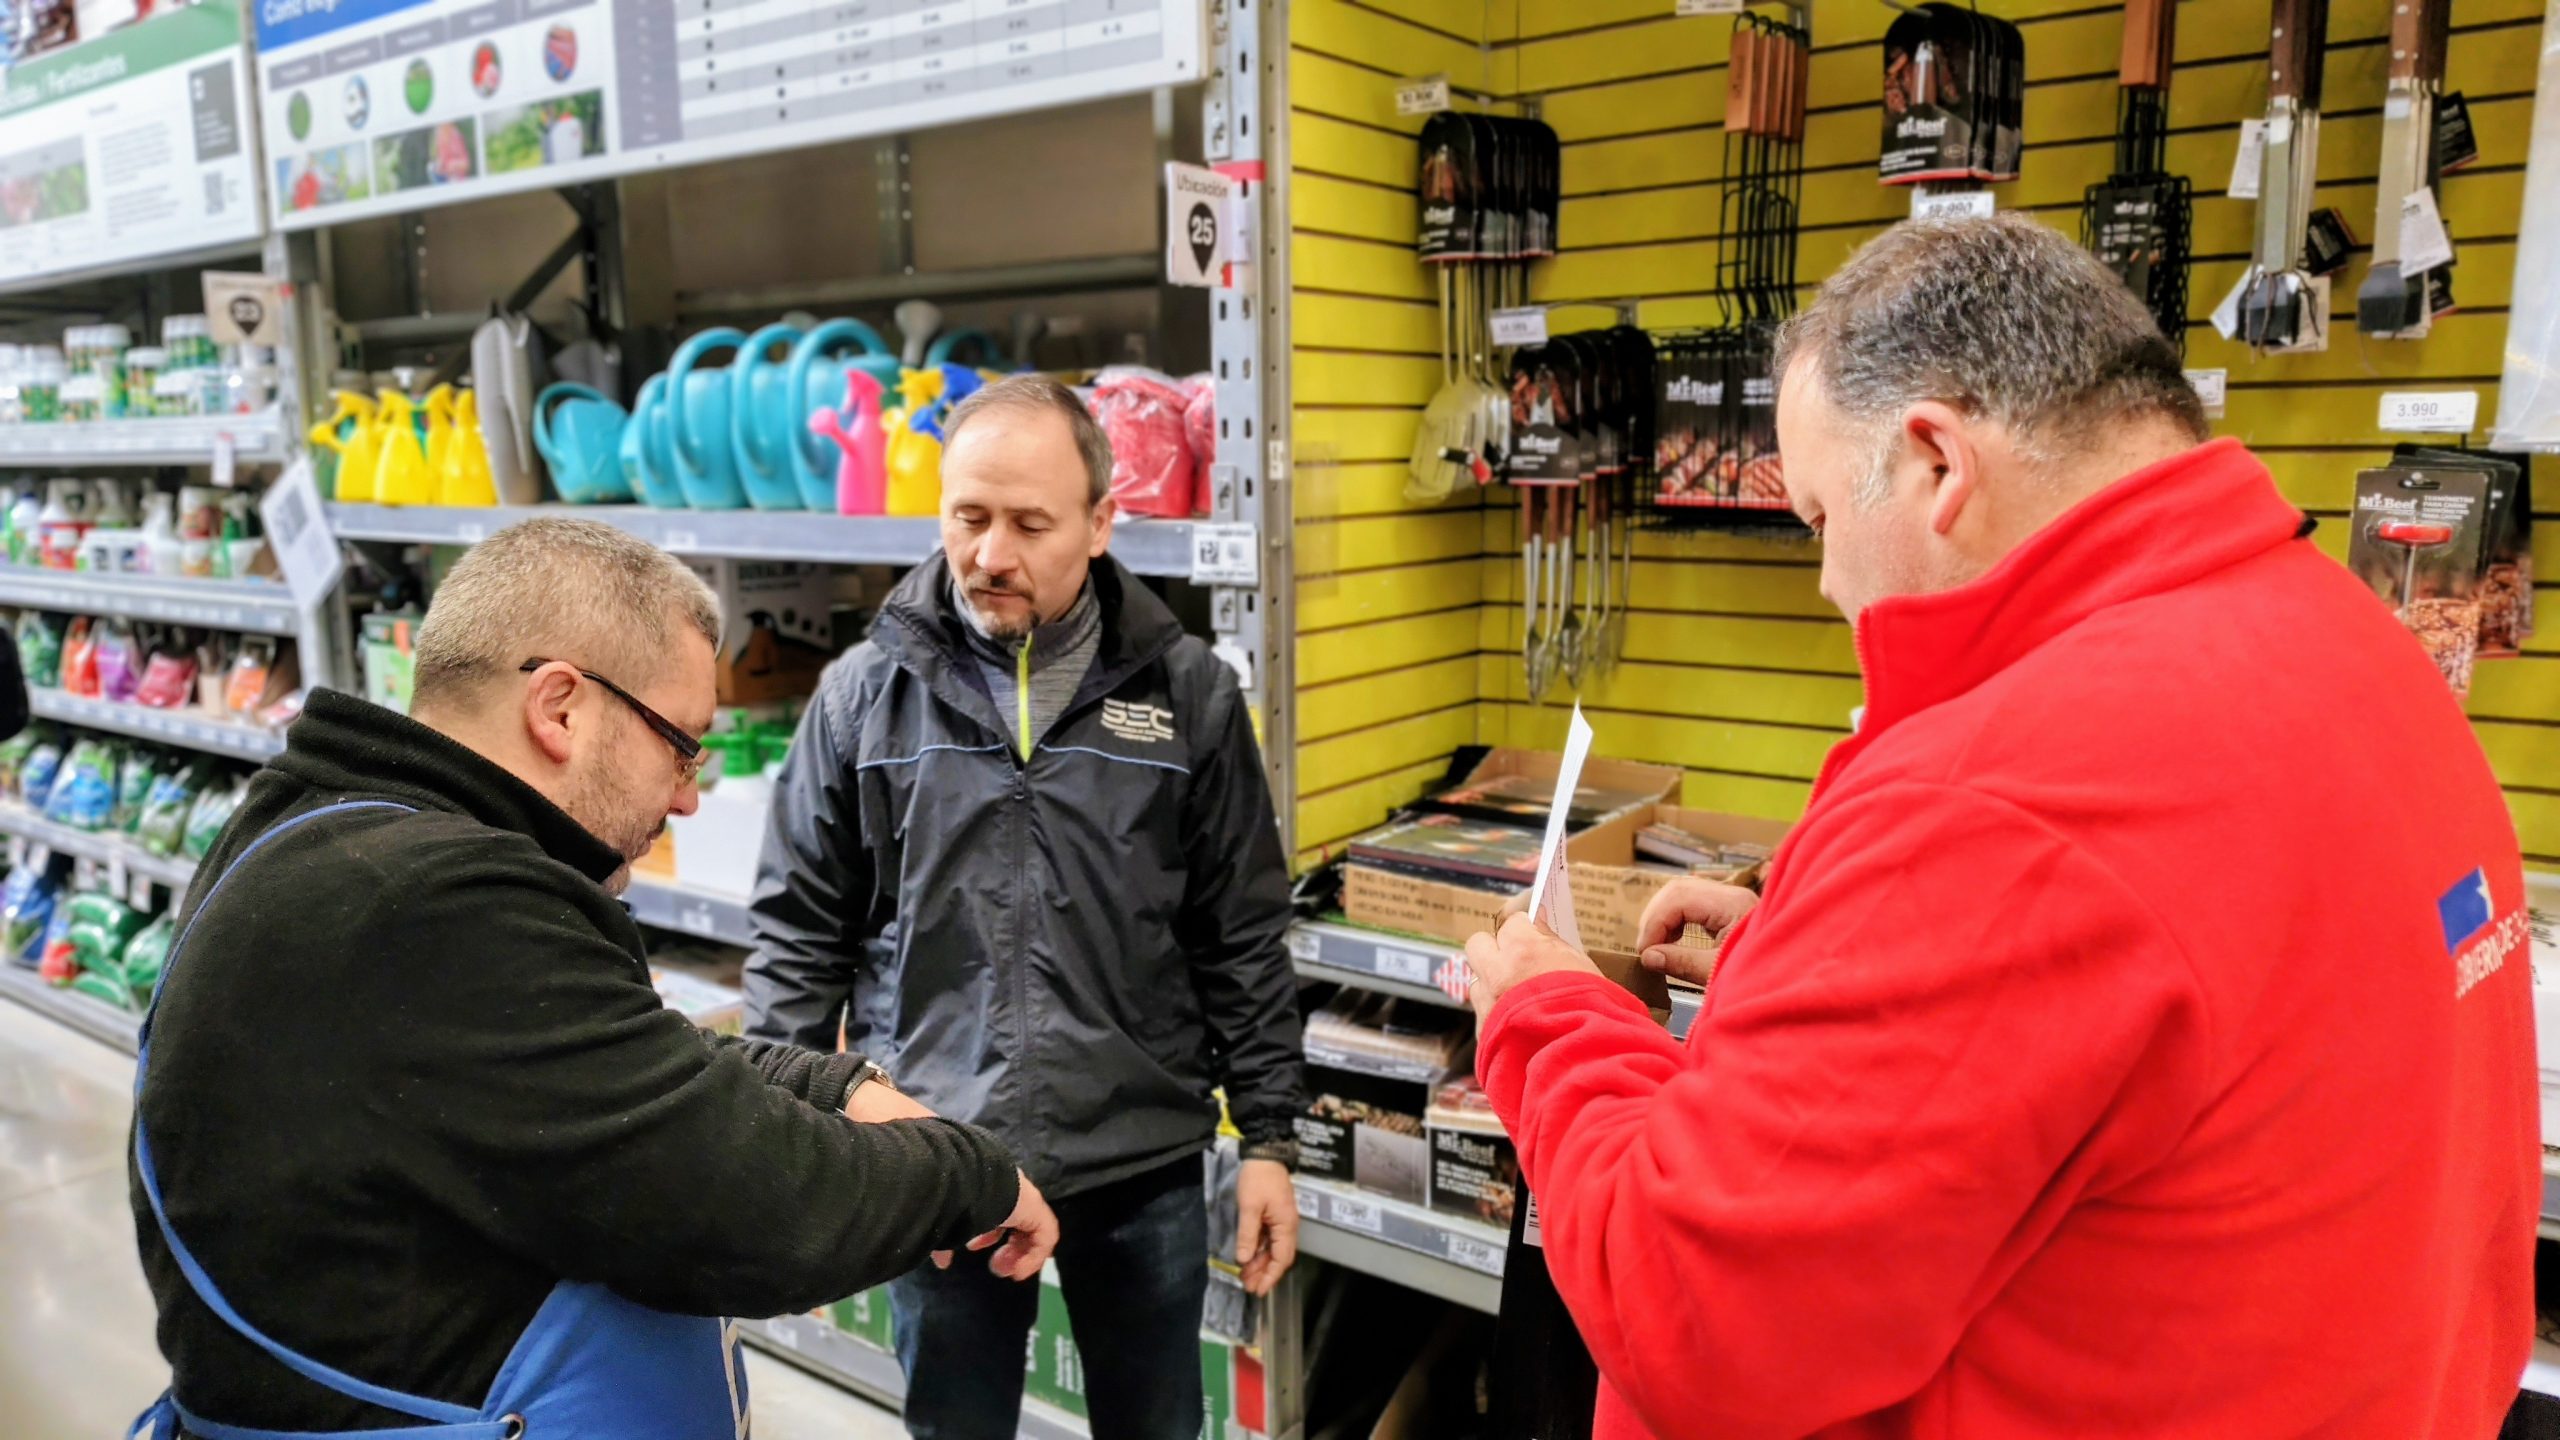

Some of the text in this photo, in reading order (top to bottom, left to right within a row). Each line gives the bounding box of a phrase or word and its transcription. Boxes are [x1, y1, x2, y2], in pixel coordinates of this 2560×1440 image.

[1177, 174, 1227, 198] Ubicación
[1191, 214, 1214, 245] 25
[2397, 402, 2438, 417] 3.990
[1102, 698, 1173, 735] SEC
